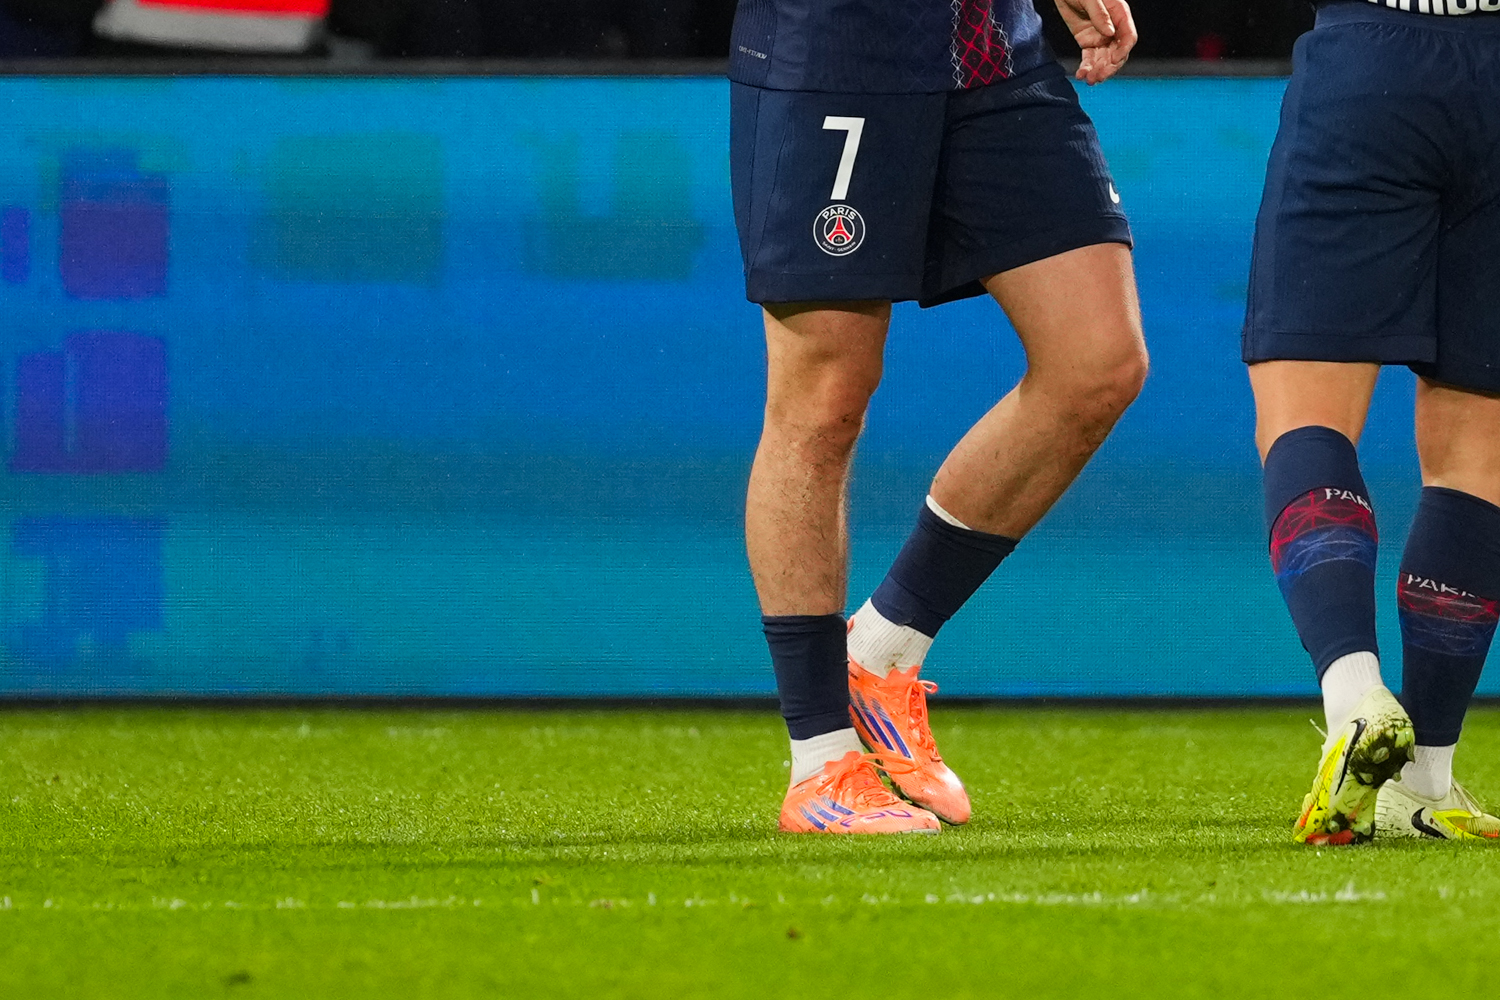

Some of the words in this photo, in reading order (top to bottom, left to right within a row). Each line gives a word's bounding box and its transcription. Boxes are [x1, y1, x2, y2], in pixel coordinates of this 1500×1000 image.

[822, 115, 866, 201] 7
[821, 206, 857, 220] PARIS
[1324, 487, 1373, 514] PAR
